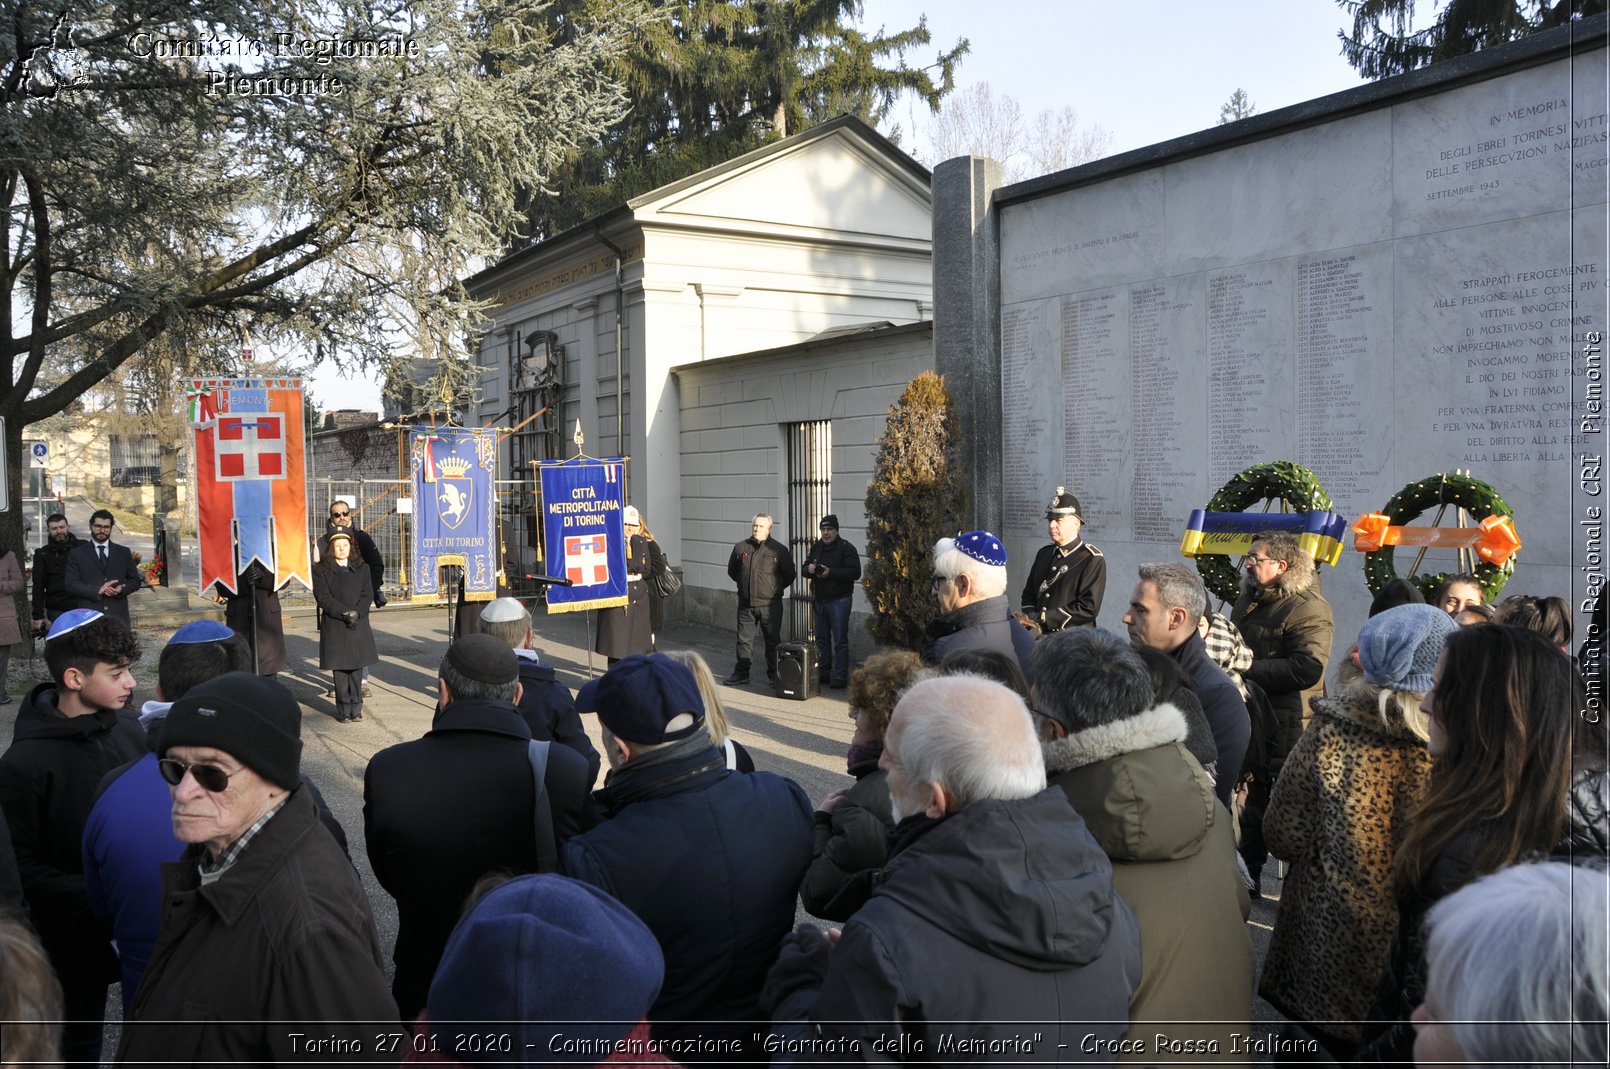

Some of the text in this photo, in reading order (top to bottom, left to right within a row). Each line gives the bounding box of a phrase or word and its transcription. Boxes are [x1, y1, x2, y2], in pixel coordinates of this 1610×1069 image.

[1490, 98, 1568, 126] IN MEMORIA
[1440, 146, 1471, 160] DEGLI
[1477, 138, 1506, 153] EBREI
[1513, 126, 1566, 145] TORINESI
[1426, 164, 1458, 179] DELLE
[1427, 186, 1474, 200] SETTEMBRE
[1480, 180, 1500, 191] 1943
[1462, 263, 1597, 289] STRAPPATI FEROCEMENTE
[1433, 299, 1455, 308] ALLE
[1462, 292, 1506, 305] PERSONE
[1513, 288, 1537, 299] ALLE
[1544, 284, 1573, 295] COSE
[1479, 307, 1515, 319] VITTIME
[1466, 316, 1592, 336] DI MOSTRVOSO CRIMINE
[1433, 346, 1453, 355] NON
[1458, 340, 1523, 353] IMPRECHIAMO
[1530, 336, 1552, 346] NON
[1468, 355, 1528, 368] INVOCAMMO
[1479, 373, 1494, 383] DIO
[1502, 373, 1516, 381] DEI
[1522, 370, 1558, 380] NOSTRI
[1503, 389, 1517, 397] LVI
[1523, 386, 1565, 396] FIDIAMO
[223, 396, 274, 407] PIEMONTE
[1438, 408, 1454, 416] PER
[1461, 406, 1479, 415] VNA
[1485, 404, 1535, 414] FRATERNA
[1444, 423, 1460, 431] PER
[1466, 422, 1484, 430] VNA
[1490, 419, 1542, 429] DVRATVRA
[1468, 434, 1590, 446] DEL DIRITTO ALLA FEDE
[1464, 454, 1487, 462] ALLA
[1538, 452, 1565, 461] ALLA
[572, 486, 596, 499] CITTÀ
[550, 500, 620, 514] METROPOLITANA
[564, 514, 605, 527] DI TORINO
[445, 538, 454, 546] DI
[456, 537, 484, 546] TORINO
